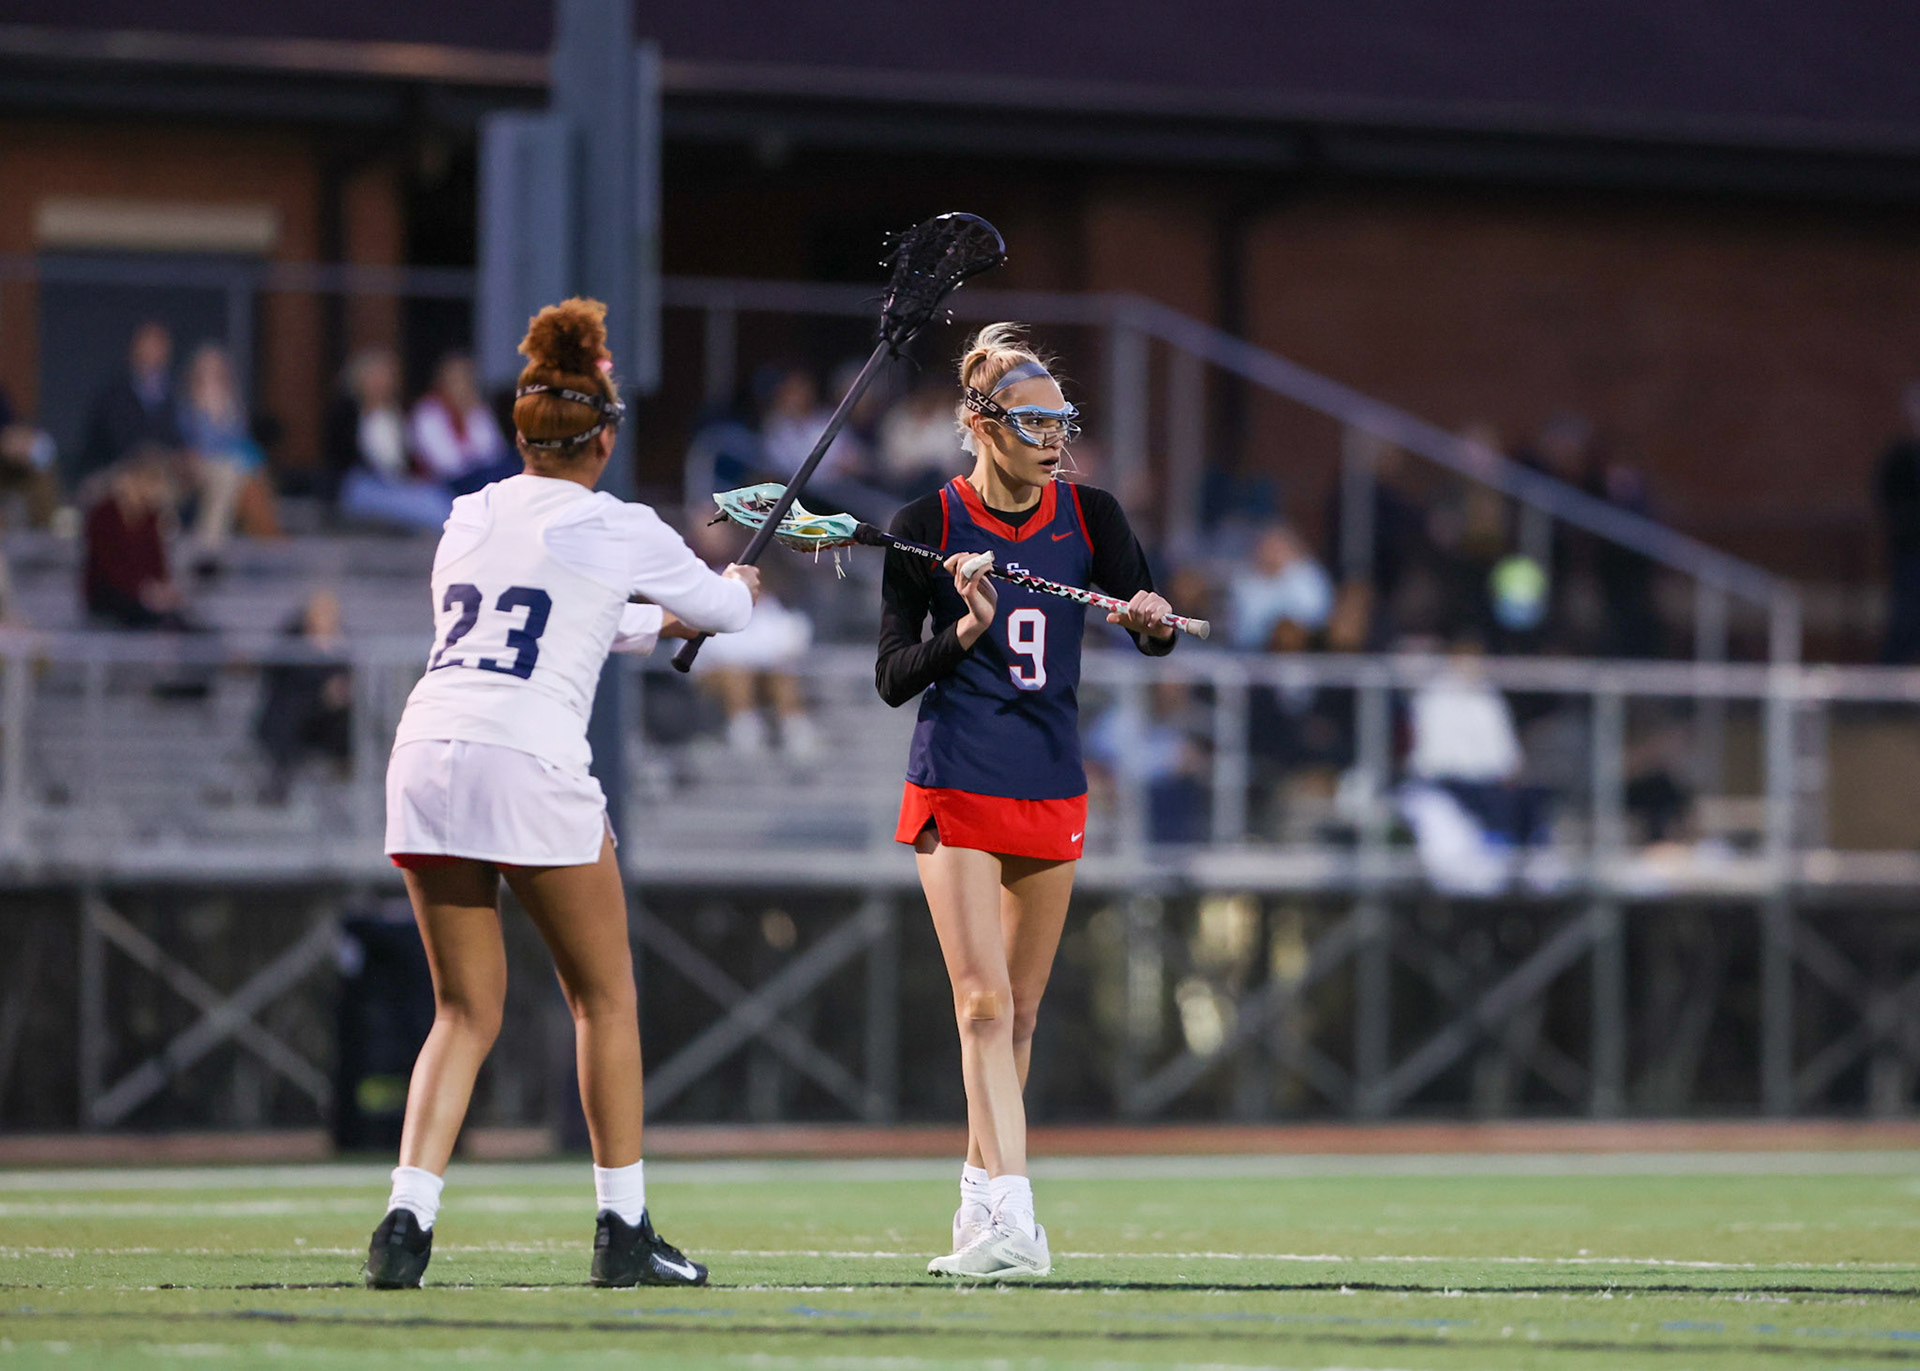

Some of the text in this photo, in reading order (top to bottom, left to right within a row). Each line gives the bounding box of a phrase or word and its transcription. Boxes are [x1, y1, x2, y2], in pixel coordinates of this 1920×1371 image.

[562, 389, 590, 404] STX
[966, 398, 983, 413] STX
[975, 393, 999, 412] STX
[893, 541, 944, 561] DYNASTY
[429, 583, 552, 680] 23
[1007, 608, 1048, 692] 9
